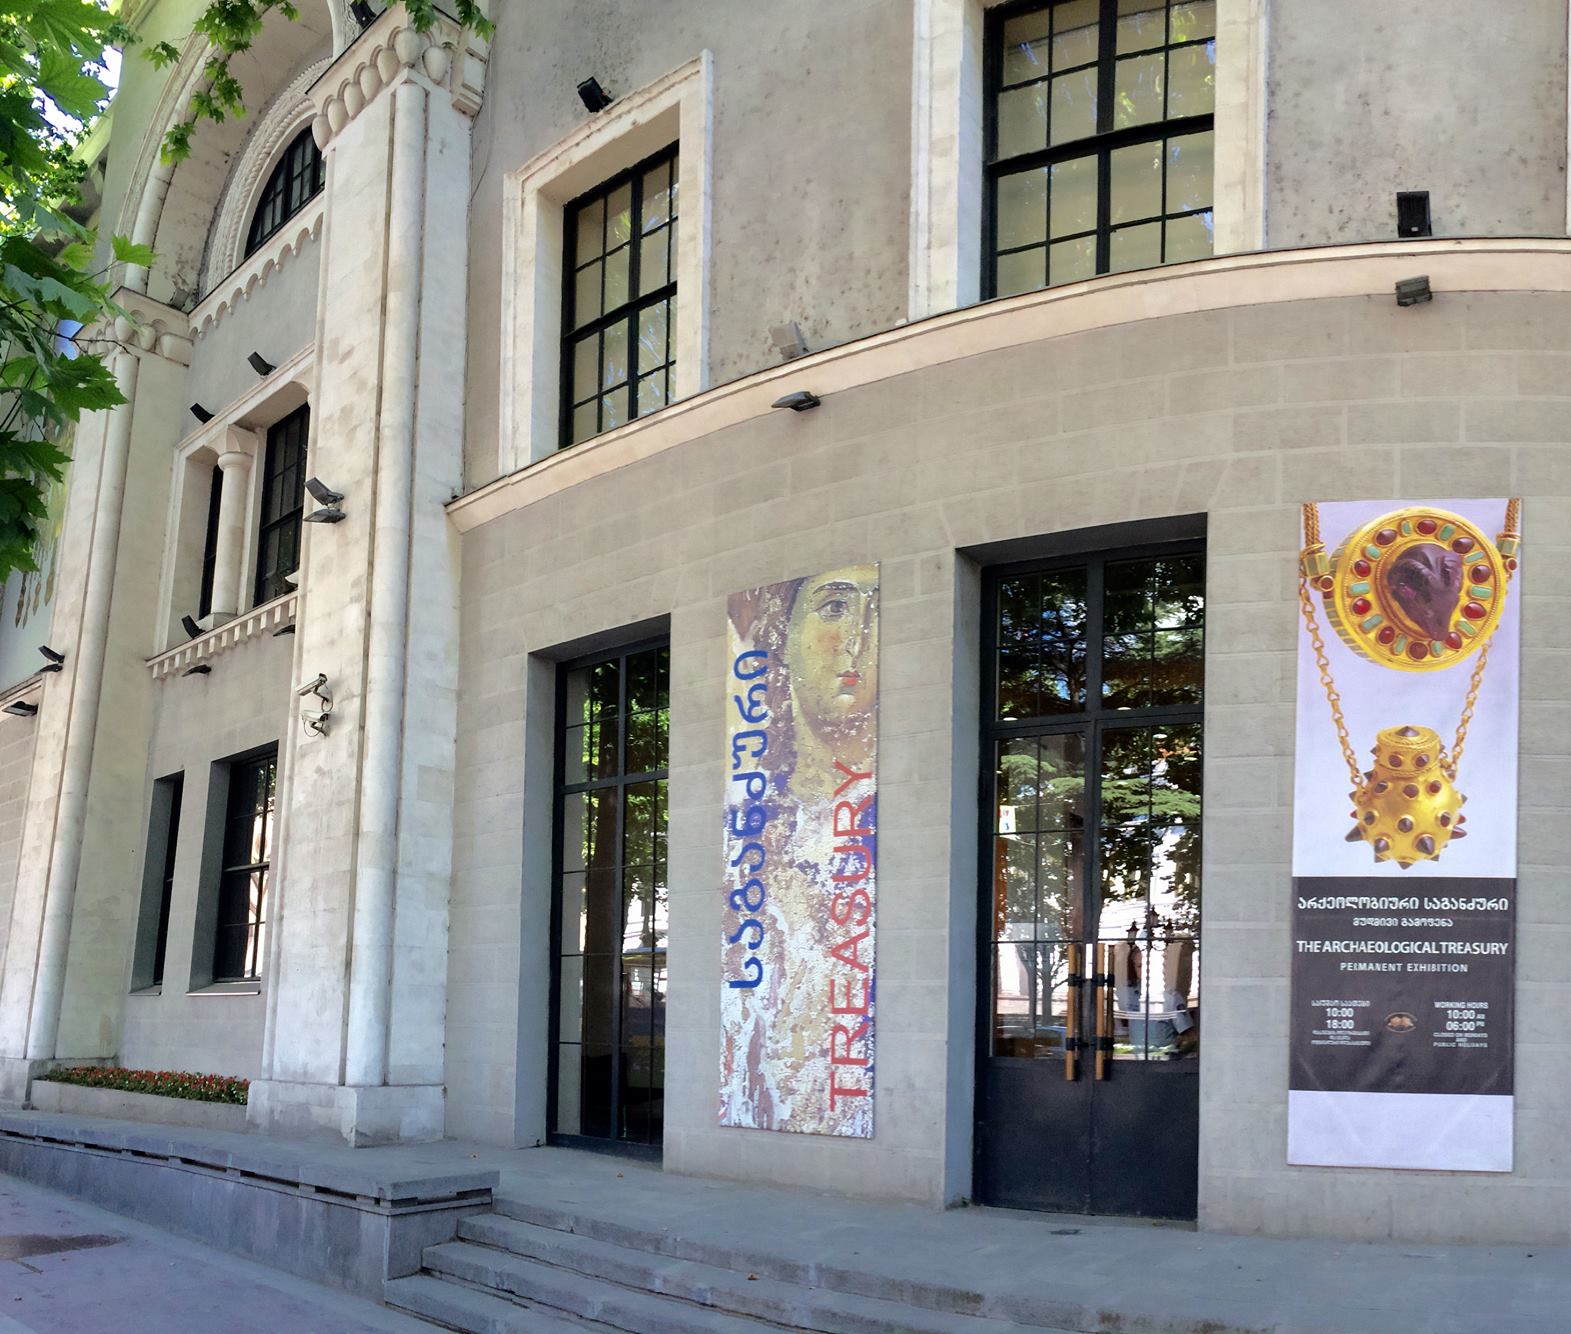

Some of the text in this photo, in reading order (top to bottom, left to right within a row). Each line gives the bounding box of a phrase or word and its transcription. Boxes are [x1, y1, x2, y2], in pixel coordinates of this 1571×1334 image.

[729, 650, 768, 988] საგანძური
[1298, 897, 1509, 910] არქეოლოგიური საგანძური
[829, 759, 873, 1112] TREASURY
[1296, 941, 1508, 954] THE ARCHAEOLOGICAL TREASURY
[1340, 962, 1468, 972] PERMANENT EXHIBITION
[1326, 1008, 1354, 1017] 10:00
[1446, 1010, 1475, 1019] 10:00
[1326, 1020, 1354, 1029] 18:00
[1446, 1021, 1475, 1030] 06:00
